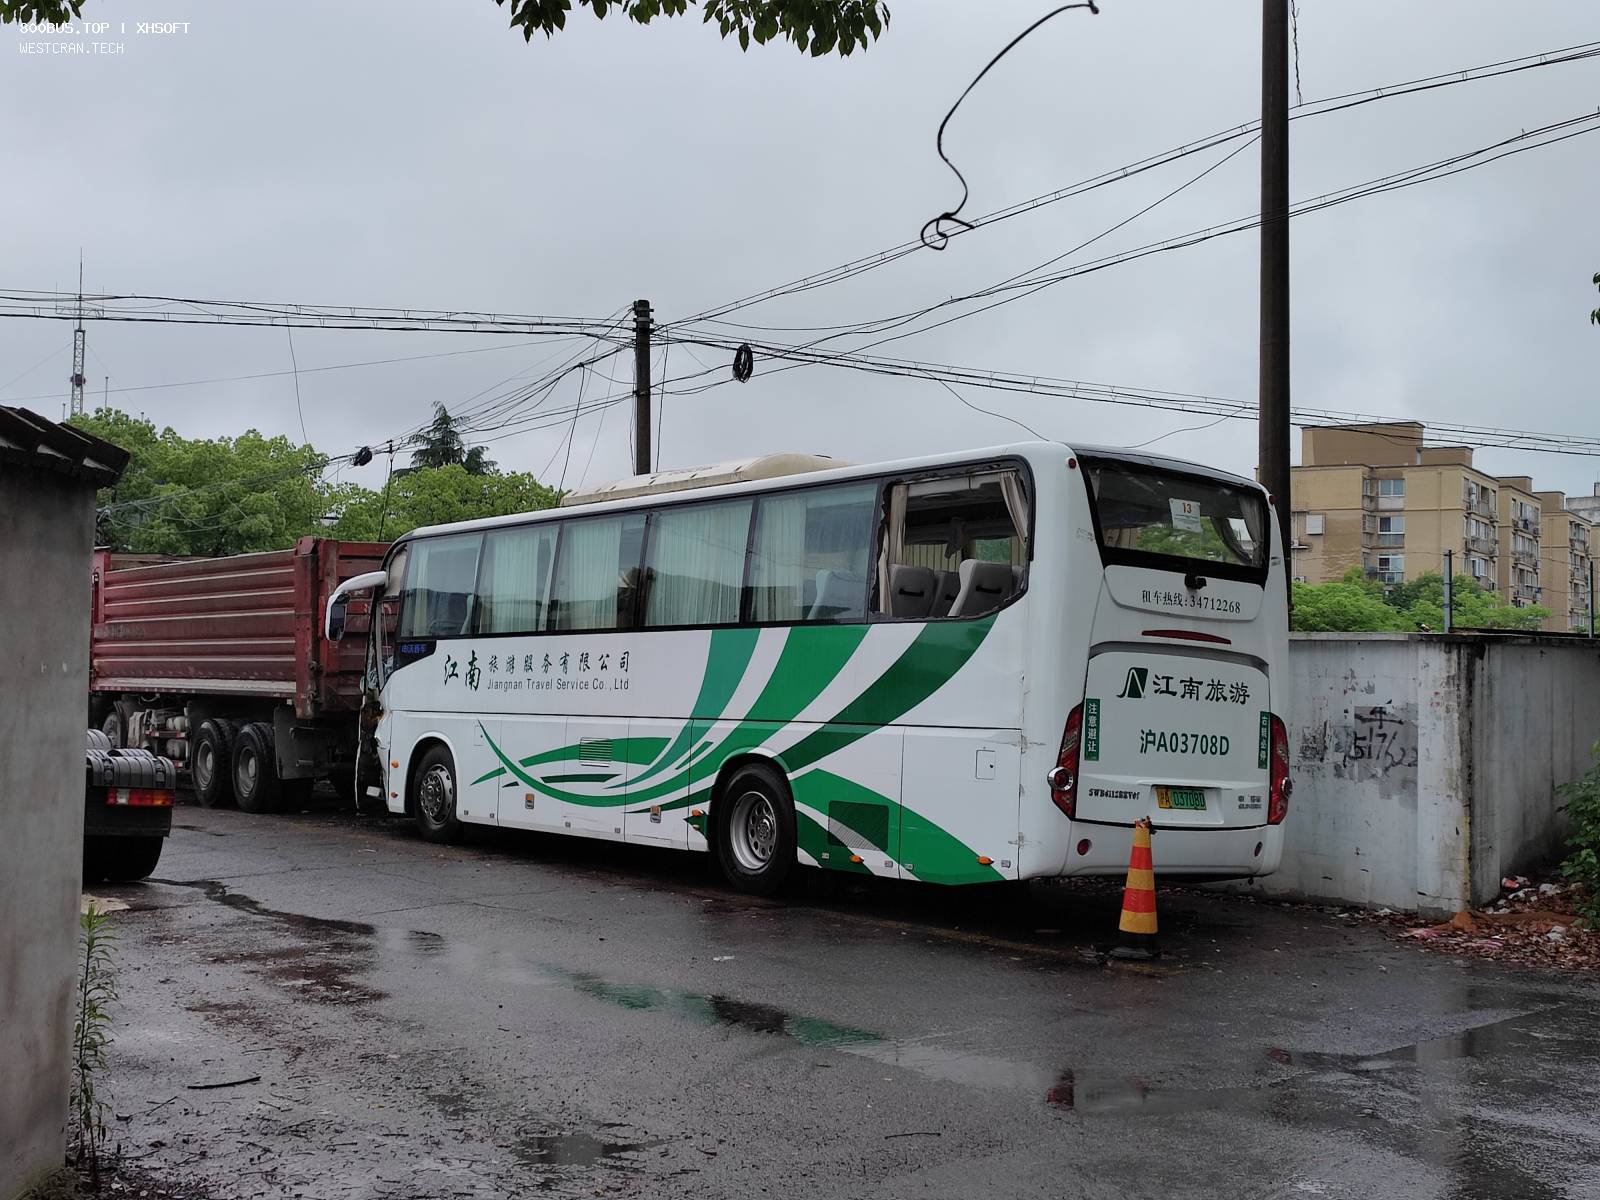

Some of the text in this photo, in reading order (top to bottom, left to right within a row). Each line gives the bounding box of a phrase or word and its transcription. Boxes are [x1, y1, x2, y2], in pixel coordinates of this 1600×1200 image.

[1182, 502, 1192, 514] 13
[487, 678, 523, 692] Jiangnan
[526, 678, 553, 690] Travel
[556, 678, 589, 690] Service
[1152, 674, 1251, 705] 江南旅游
[1140, 729, 1230, 756] 沪A03708D
